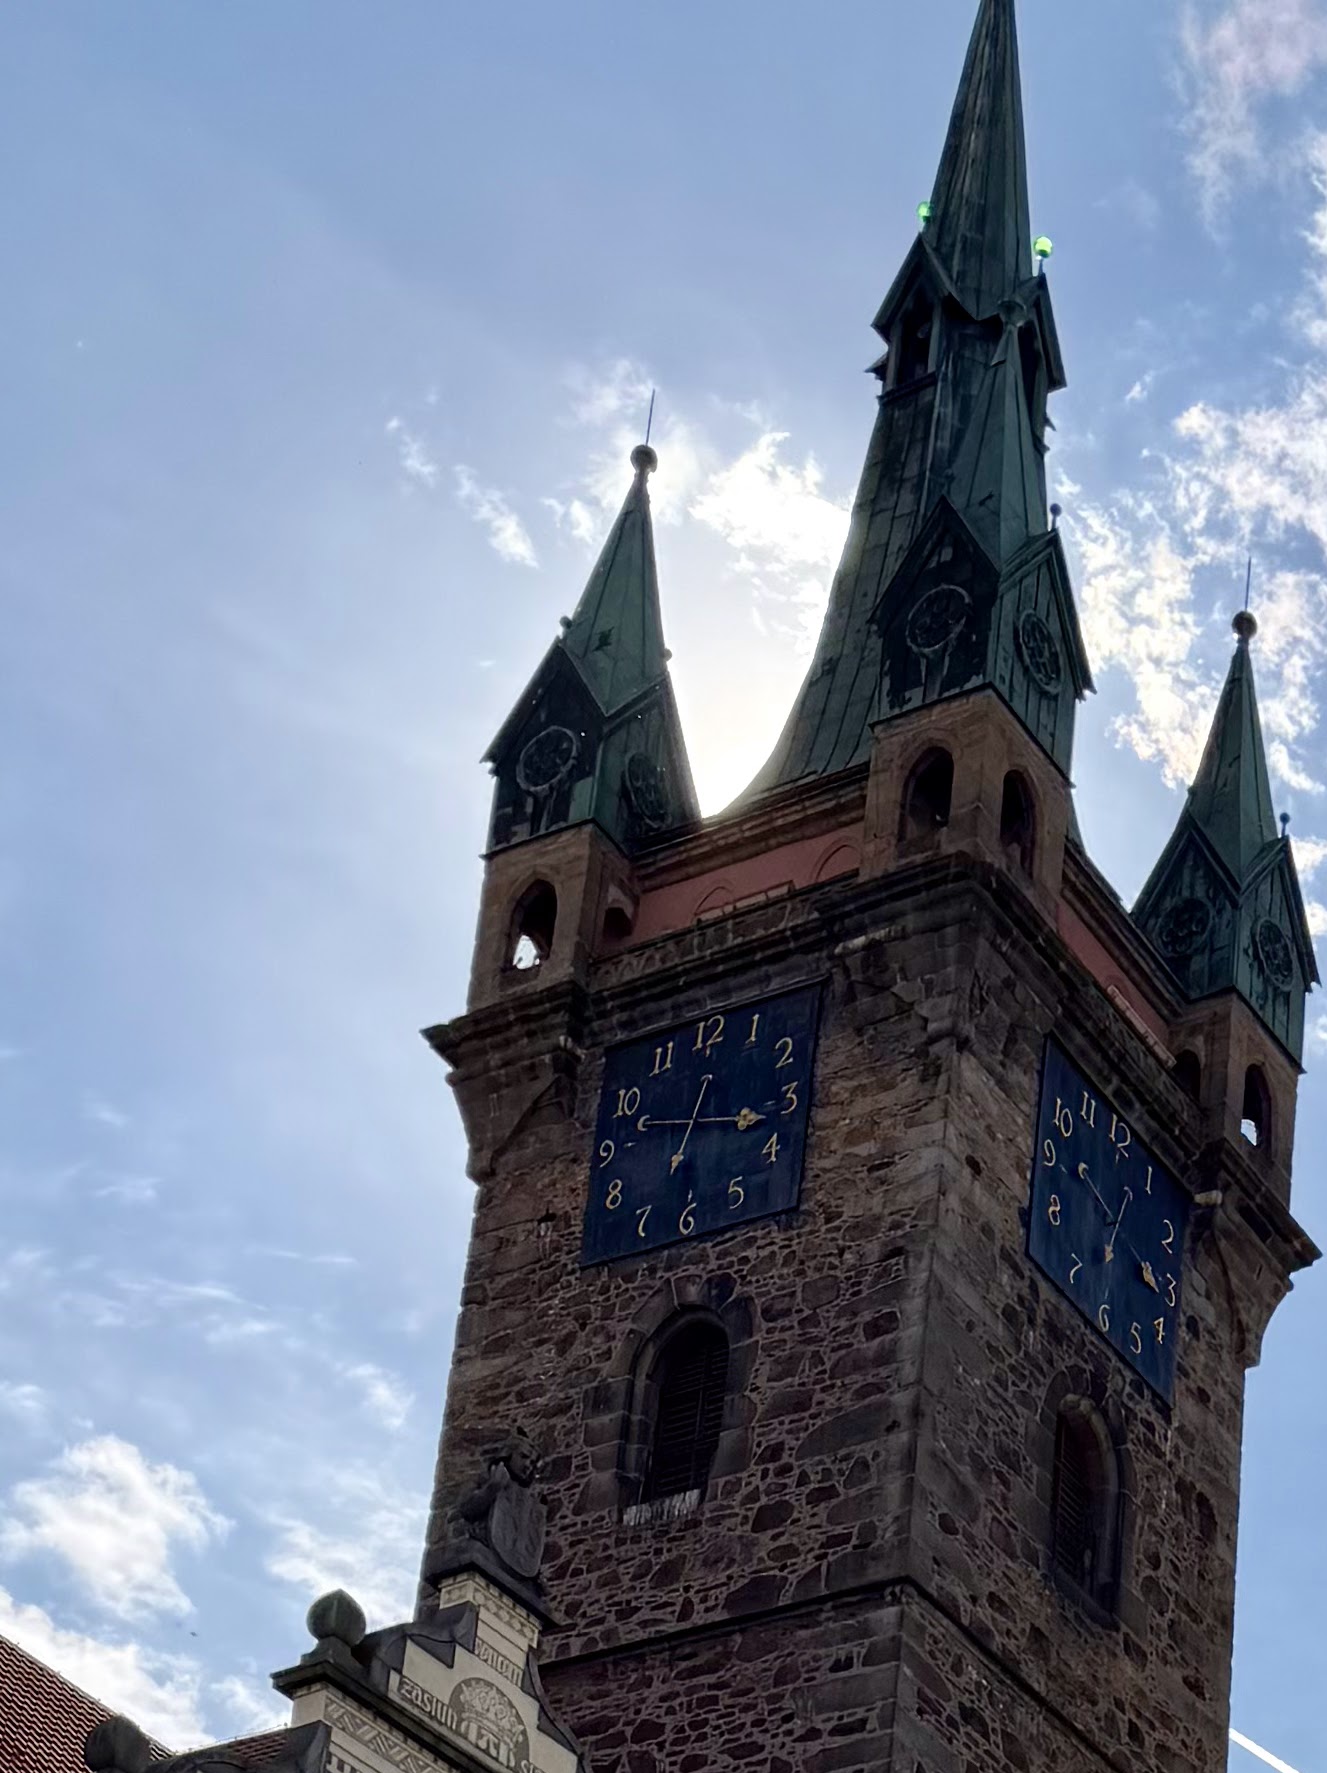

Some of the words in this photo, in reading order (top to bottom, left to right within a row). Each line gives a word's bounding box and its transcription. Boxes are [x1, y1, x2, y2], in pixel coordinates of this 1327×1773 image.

[692, 1016, 724, 1050] 12
[747, 1014, 759, 1042] 1
[650, 1042, 673, 1075] 11
[775, 1038, 793, 1067] 2
[616, 1088, 640, 1116] 10
[780, 1081, 798, 1114] 3
[1080, 1091, 1096, 1126] 11
[1052, 1099, 1072, 1136] 10
[761, 1133, 779, 1162] 4
[1109, 1114, 1132, 1158] 12
[600, 1141, 615, 1168] 9
[1043, 1139, 1056, 1166] 9
[605, 1180, 622, 1210] 8
[728, 1178, 744, 1208] 5
[1145, 1166, 1152, 1194] 1
[636, 1206, 652, 1238] 7
[679, 1203, 696, 1234] 6
[1048, 1195, 1061, 1225] 8
[1161, 1220, 1174, 1254] 2
[1068, 1254, 1083, 1282] 7
[1165, 1274, 1177, 1306] 3
[1098, 1305, 1110, 1331] 6
[1153, 1318, 1165, 1344] 4
[1129, 1323, 1142, 1353] 5
